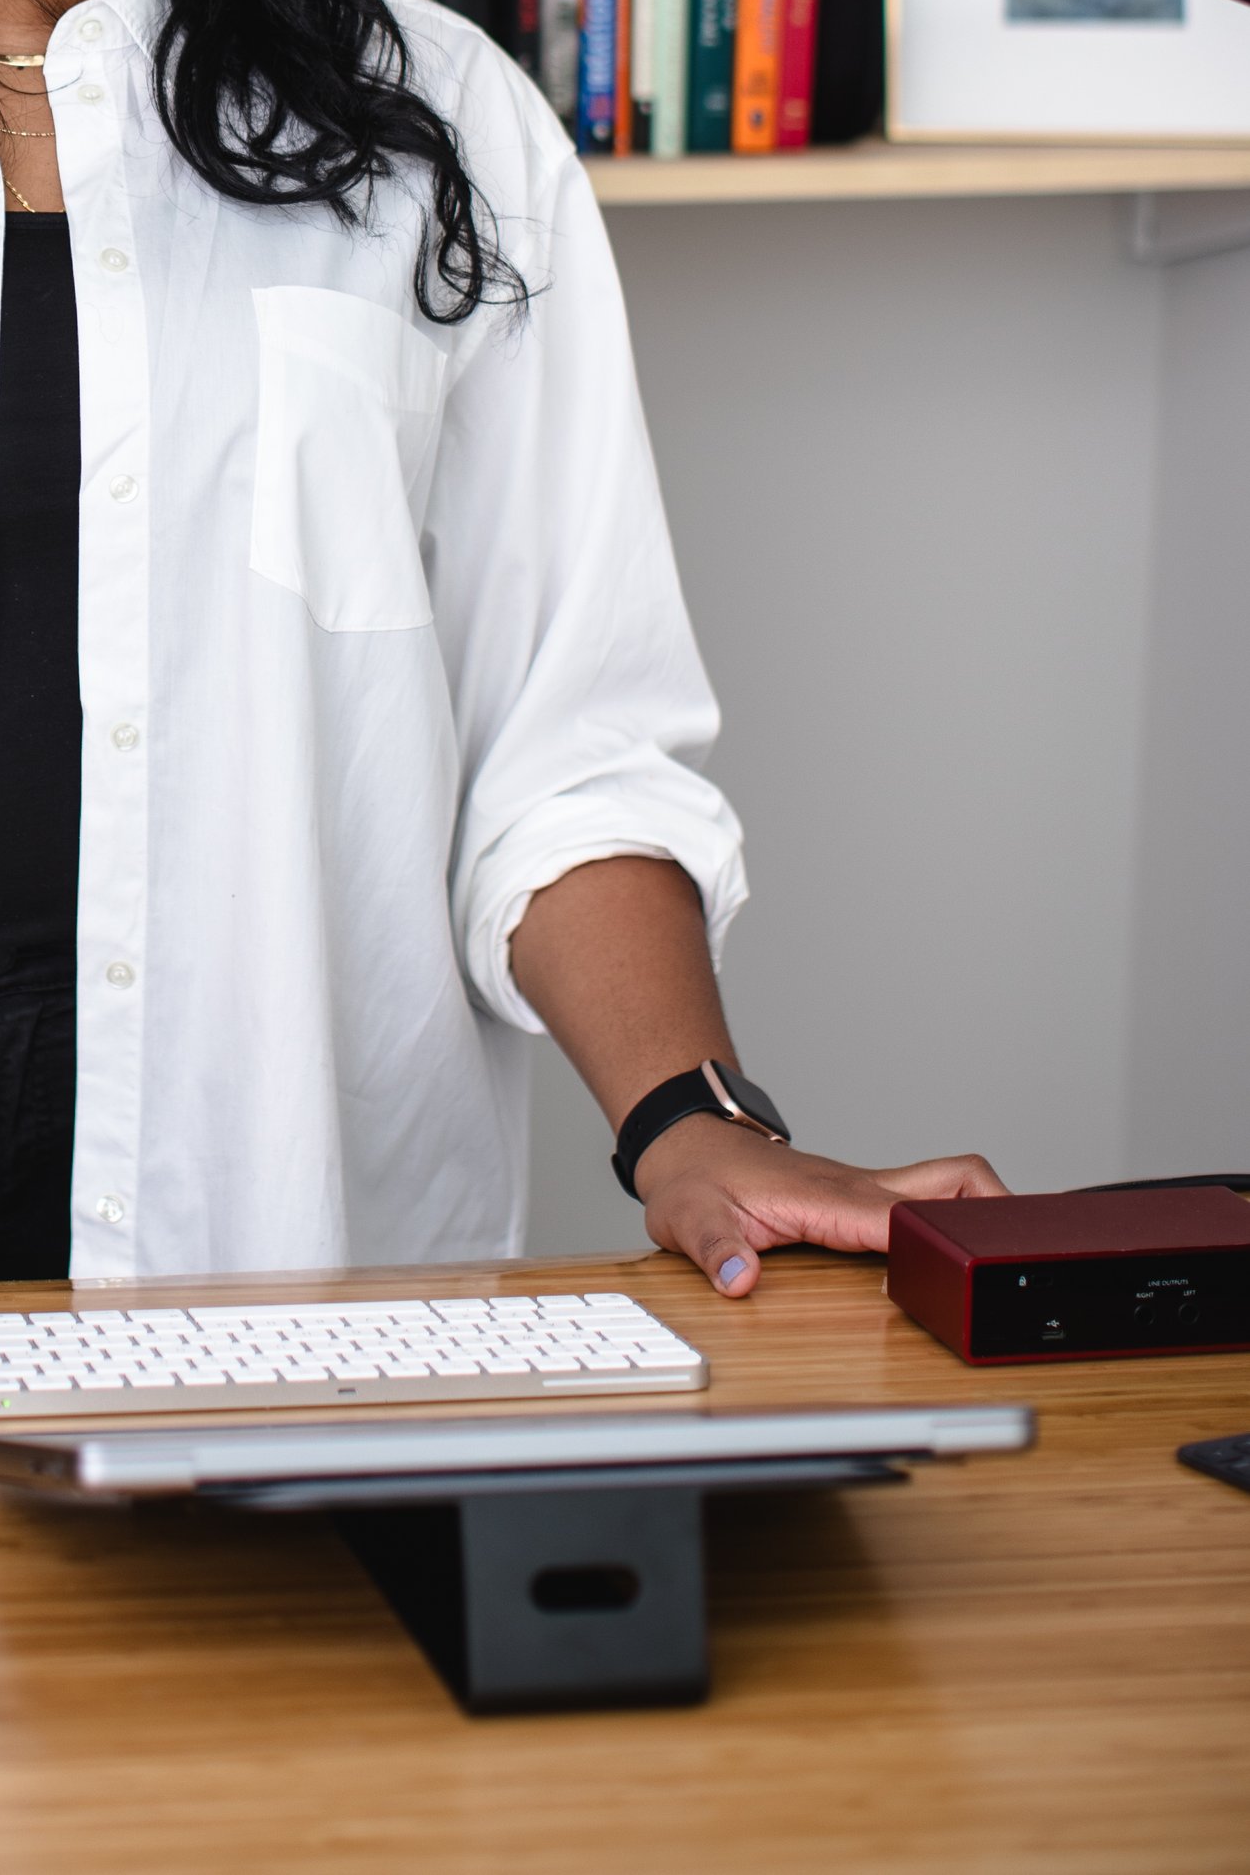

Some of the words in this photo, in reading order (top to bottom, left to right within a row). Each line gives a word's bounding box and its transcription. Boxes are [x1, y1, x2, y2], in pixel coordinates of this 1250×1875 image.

[1148, 1280, 1161, 1288] LINE
[1161, 1278, 1190, 1287] OUTPUTS
[1135, 1291, 1155, 1299] RIGHT
[1182, 1289, 1197, 1297] LEFT
